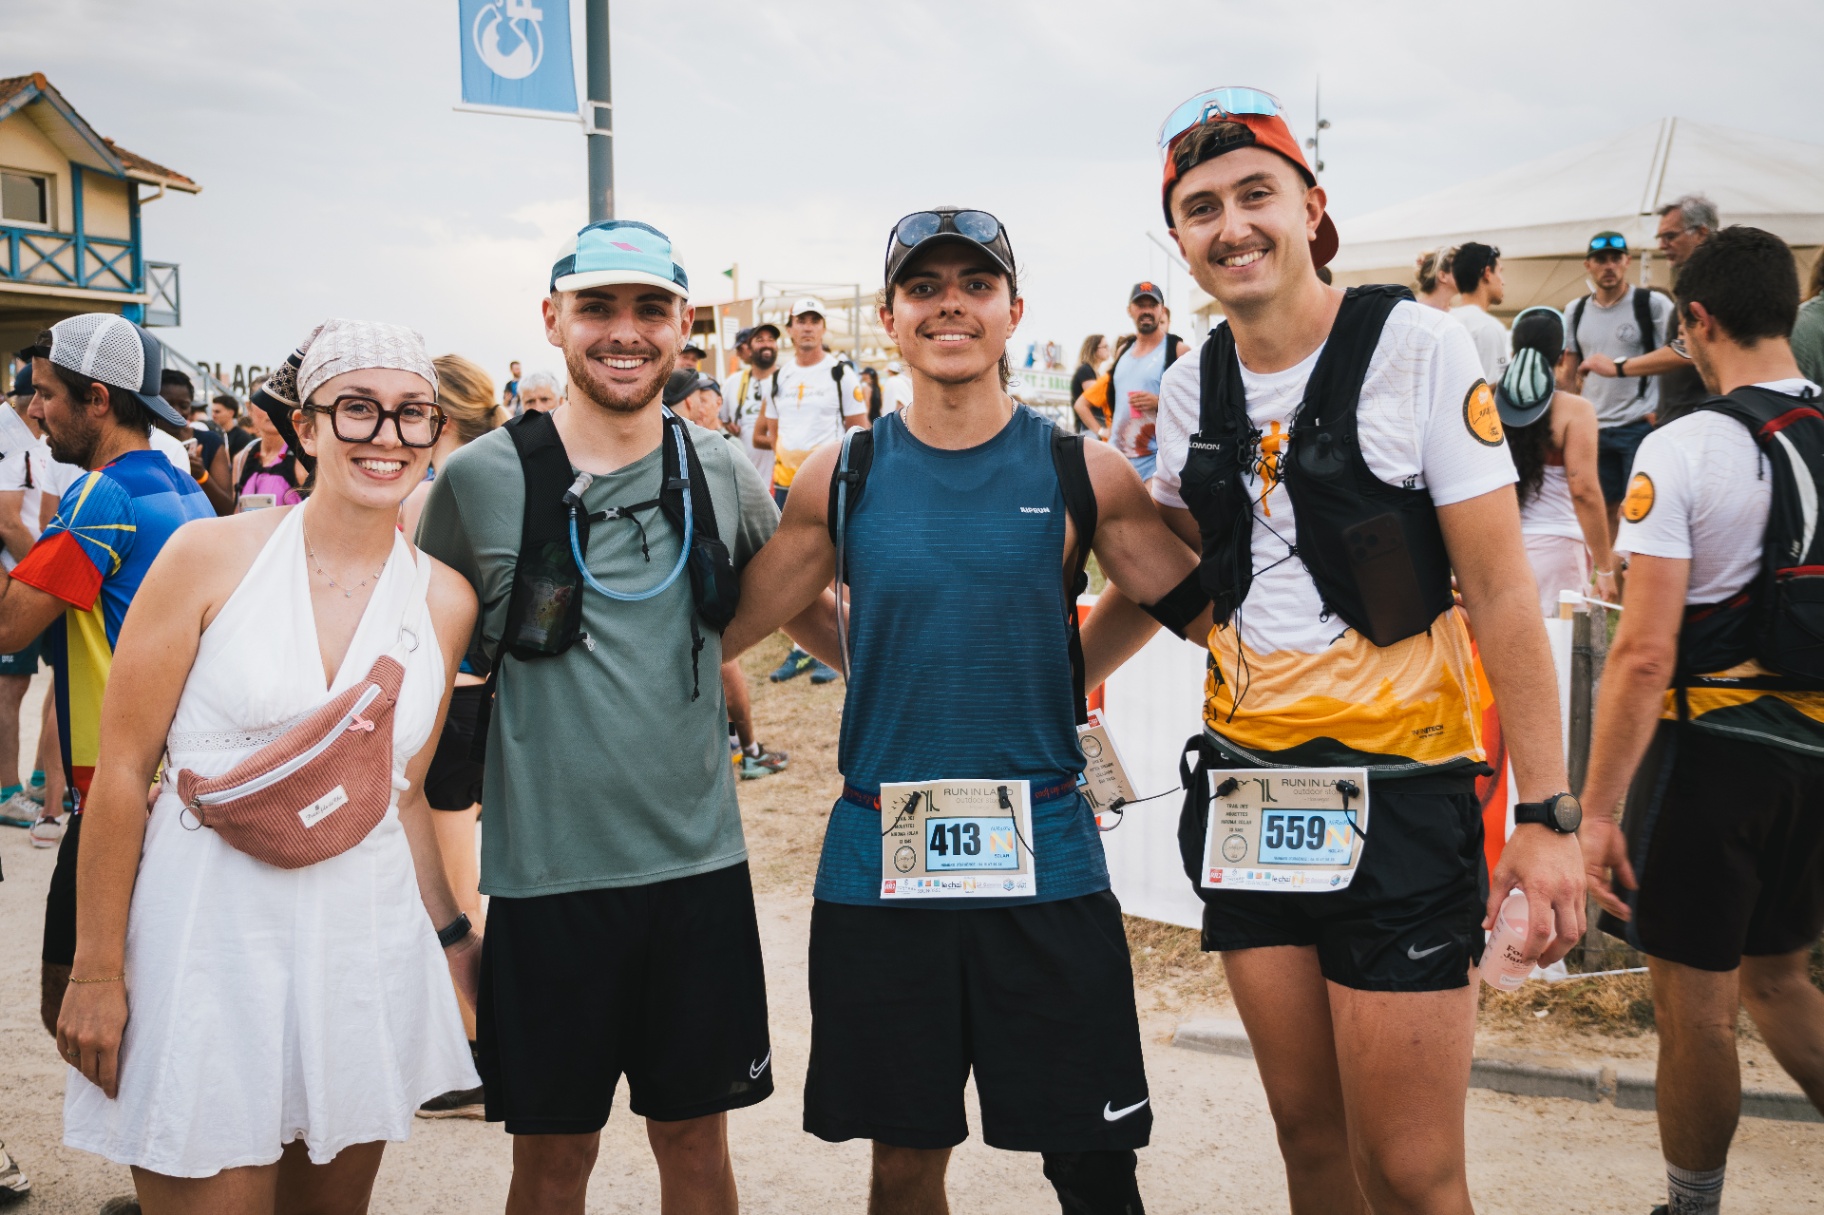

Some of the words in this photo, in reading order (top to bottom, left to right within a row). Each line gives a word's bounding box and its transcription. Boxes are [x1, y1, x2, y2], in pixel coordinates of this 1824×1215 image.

[1281, 778, 1306, 787] RUN
[1308, 778, 1320, 787] IN
[1322, 778, 1356, 788] LAD
[943, 787, 968, 796] RUN
[970, 787, 981, 796] IN
[983, 787, 1014, 796] LAD
[956, 796, 983, 804] outdoor
[1266, 814, 1326, 850] 559
[929, 822, 981, 856] 413
